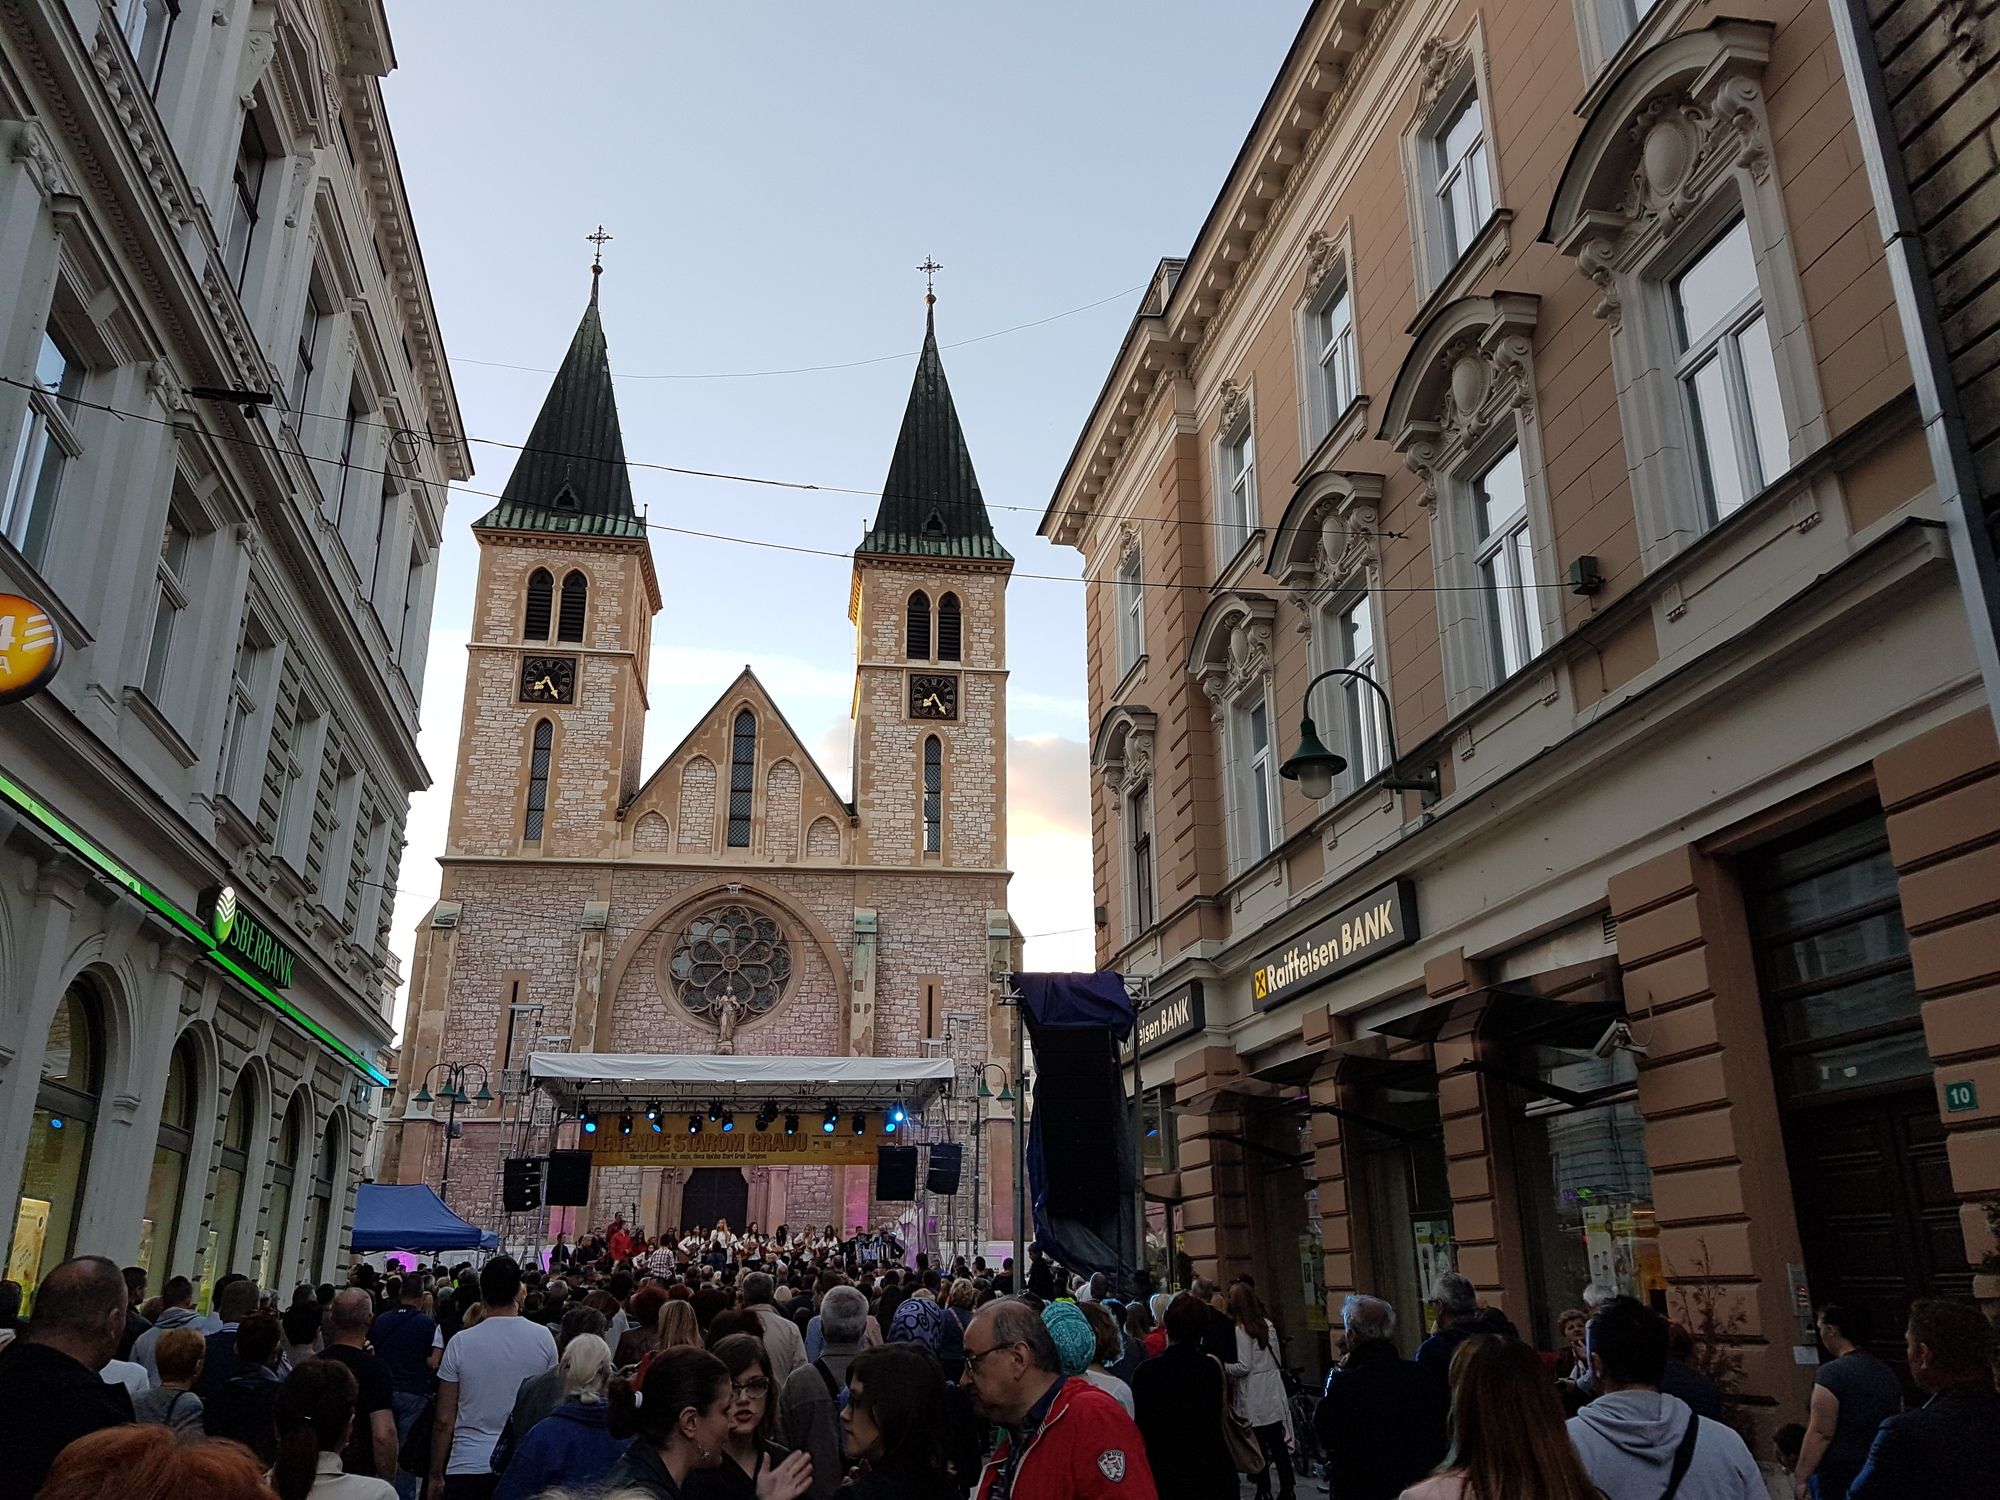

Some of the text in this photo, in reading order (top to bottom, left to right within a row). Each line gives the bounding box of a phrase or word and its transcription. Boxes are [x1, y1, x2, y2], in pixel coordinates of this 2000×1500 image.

[230, 909, 295, 989] SBERBANK
[1266, 899, 1394, 994] Raiffeisen BANK
[1161, 996, 1189, 1035] BANK
[1950, 1087, 1970, 1105] 10
[673, 1132, 745, 1152] STAROM
[748, 1132, 808, 1152] GRADU
